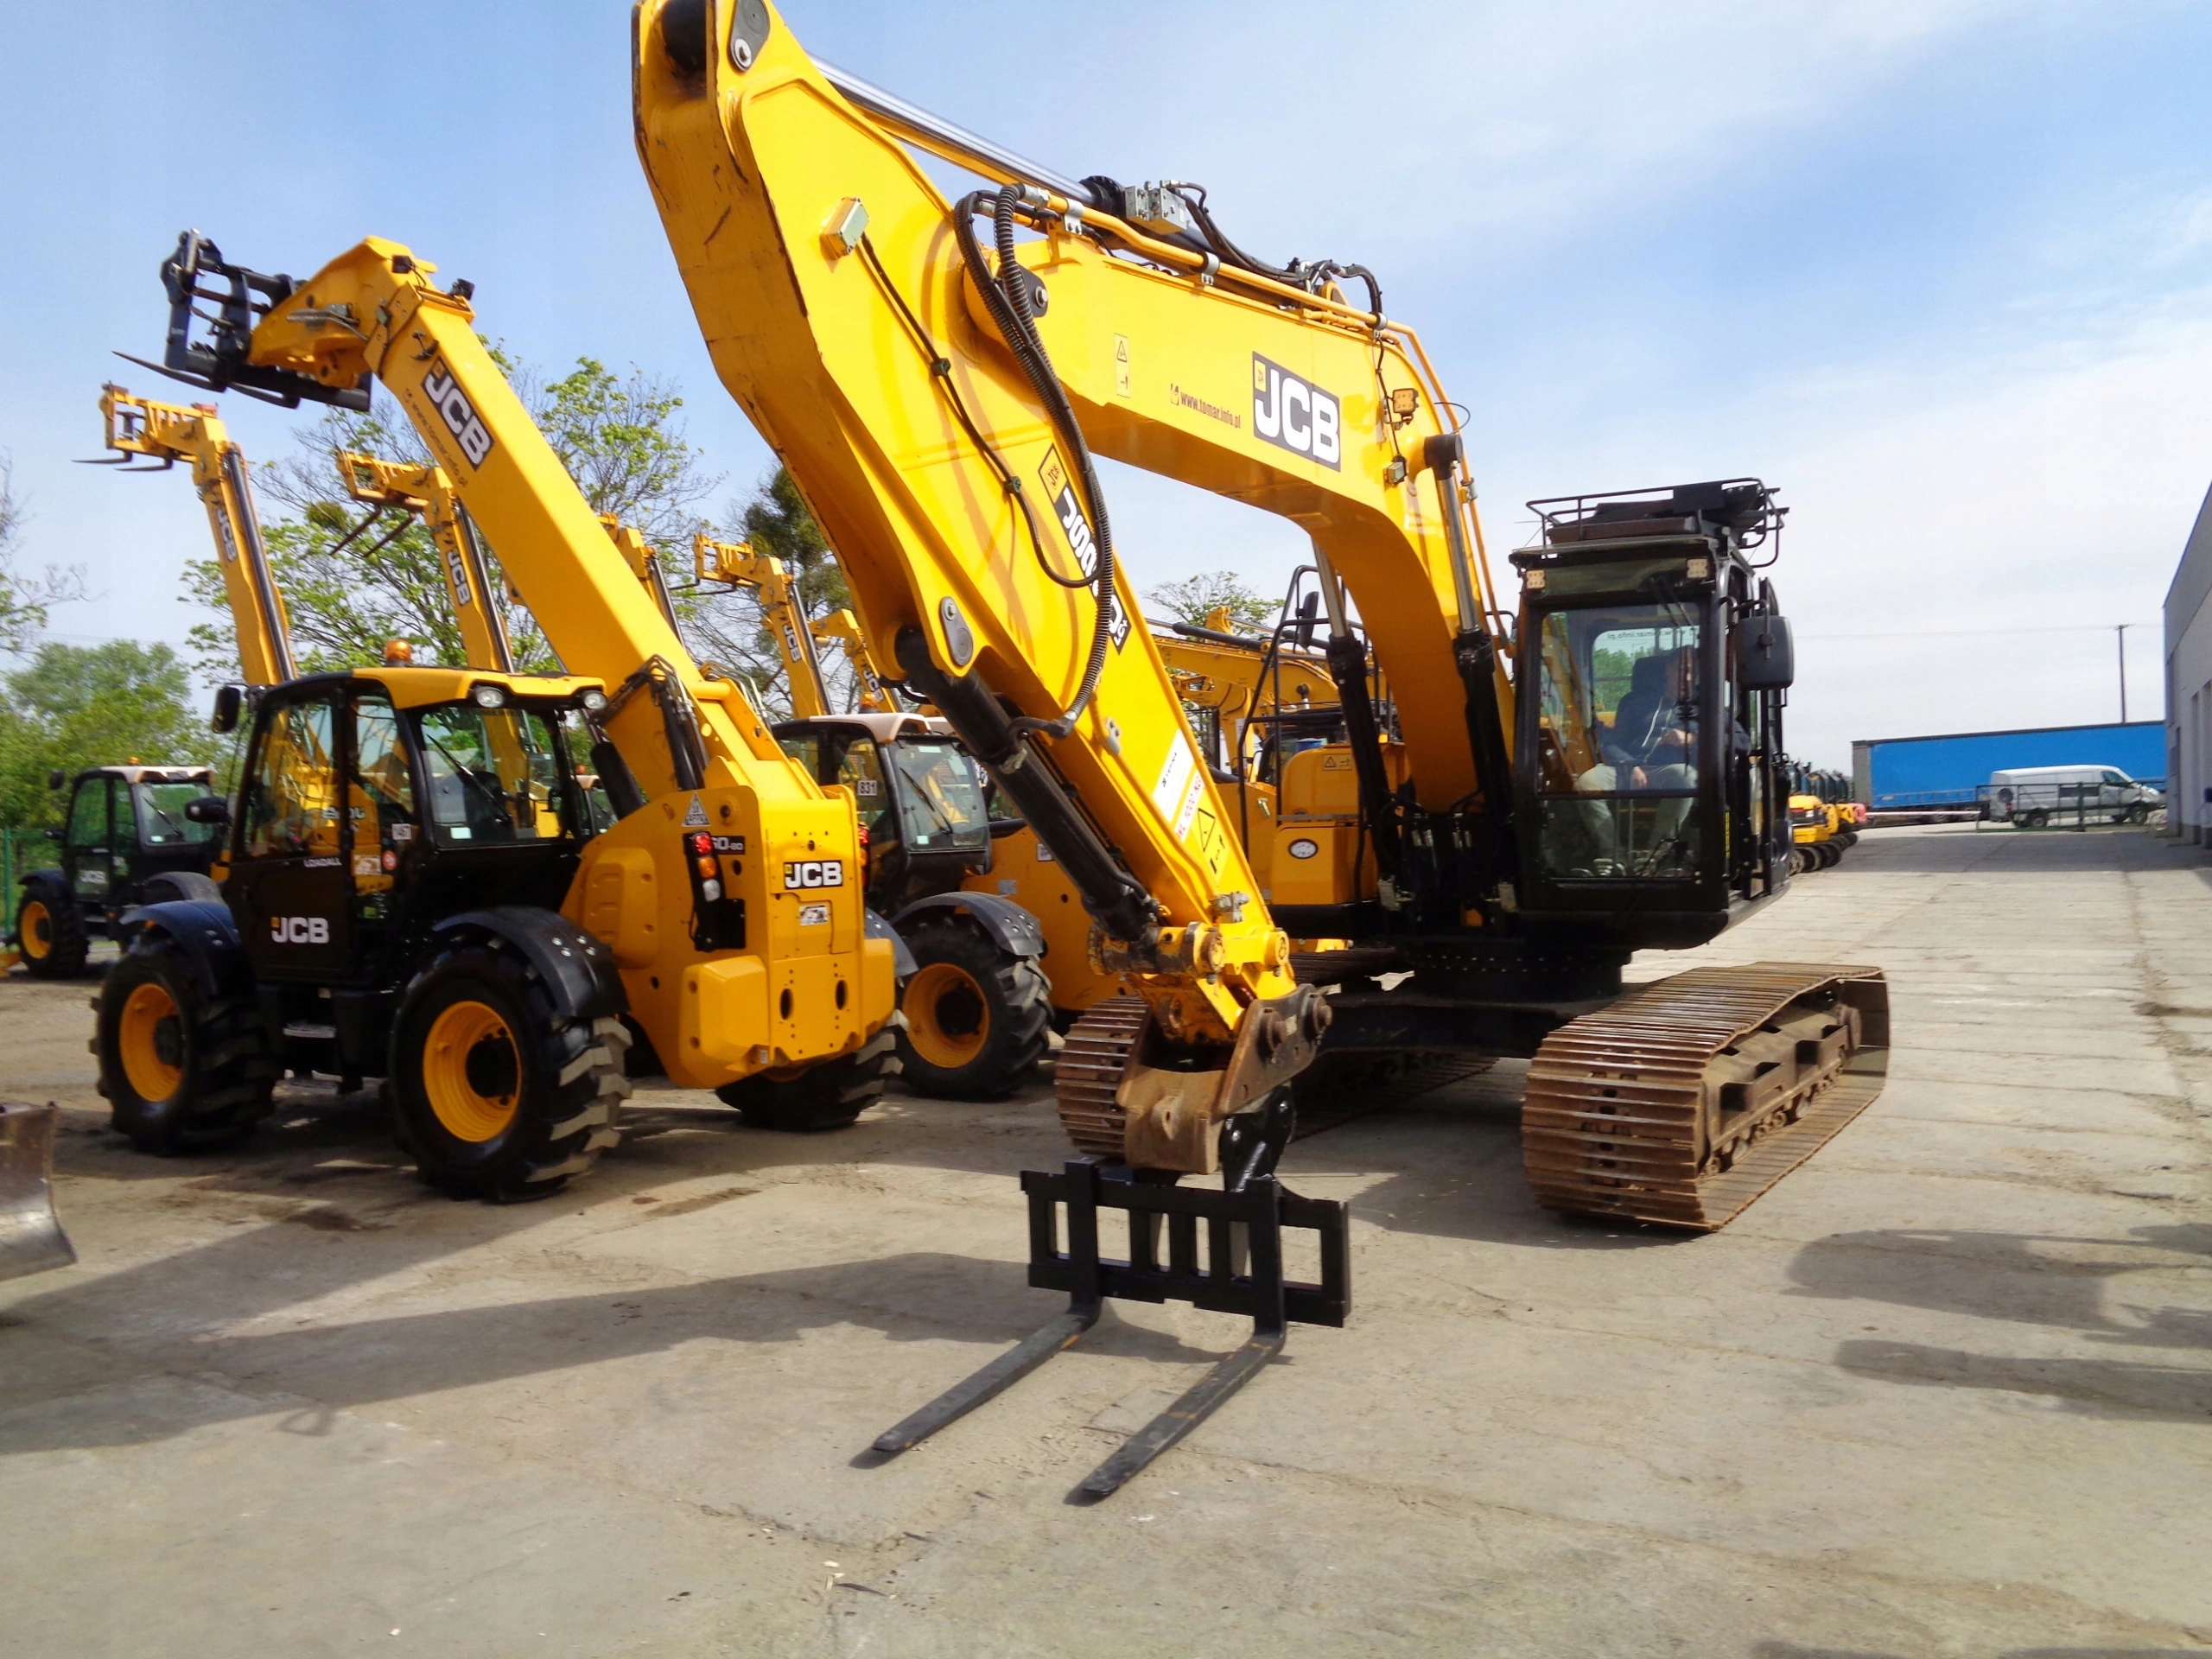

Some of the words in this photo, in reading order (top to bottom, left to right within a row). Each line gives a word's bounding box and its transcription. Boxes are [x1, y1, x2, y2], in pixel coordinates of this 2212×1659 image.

[424, 373, 492, 465] JCB
[1255, 368, 1340, 464] JCB
[217, 508, 238, 562] JCB
[447, 550, 471, 605] JCB
[783, 624, 801, 662] JCB
[784, 861, 843, 888] JCB
[270, 917, 330, 944] JCB
